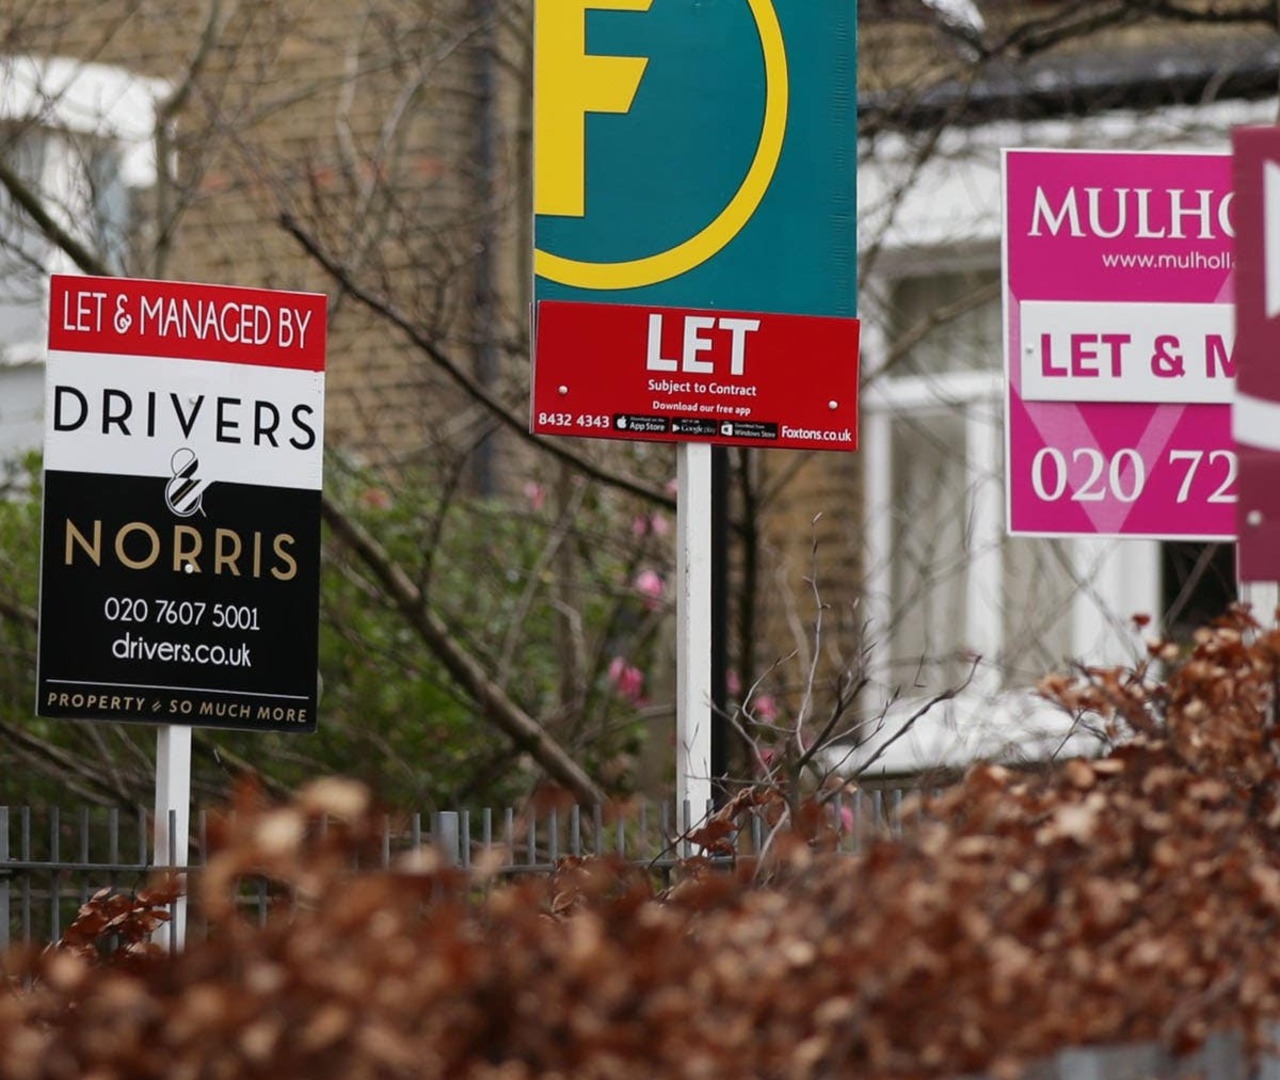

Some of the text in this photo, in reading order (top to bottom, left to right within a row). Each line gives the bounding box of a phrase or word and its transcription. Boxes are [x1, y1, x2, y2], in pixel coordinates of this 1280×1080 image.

[63, 290, 312, 349] LET & MANAGED BY
[646, 313, 761, 375] LET
[1040, 333, 1131, 378] LET
[1150, 334, 1186, 379] &
[648, 379, 757, 397] Subject to Contract
[52, 385, 317, 450] DRIVERS
[538, 412, 610, 428] 8432 4343
[652, 400, 751, 417] Download our free app
[629, 421, 666, 432] App Store
[781, 425, 852, 442] Foxtons.co.uk
[164, 447, 207, 518] &
[1030, 447, 1239, 504] 020 72
[65, 518, 298, 582] NORRIS
[104, 597, 260, 631] 020 7607 5001
[112, 632, 252, 667] drivers.co.uk
[47, 692, 146, 711] PROPERTY
[169, 699, 193, 714] SO
[199, 701, 251, 718] MUCH
[256, 706, 308, 723] MORE
